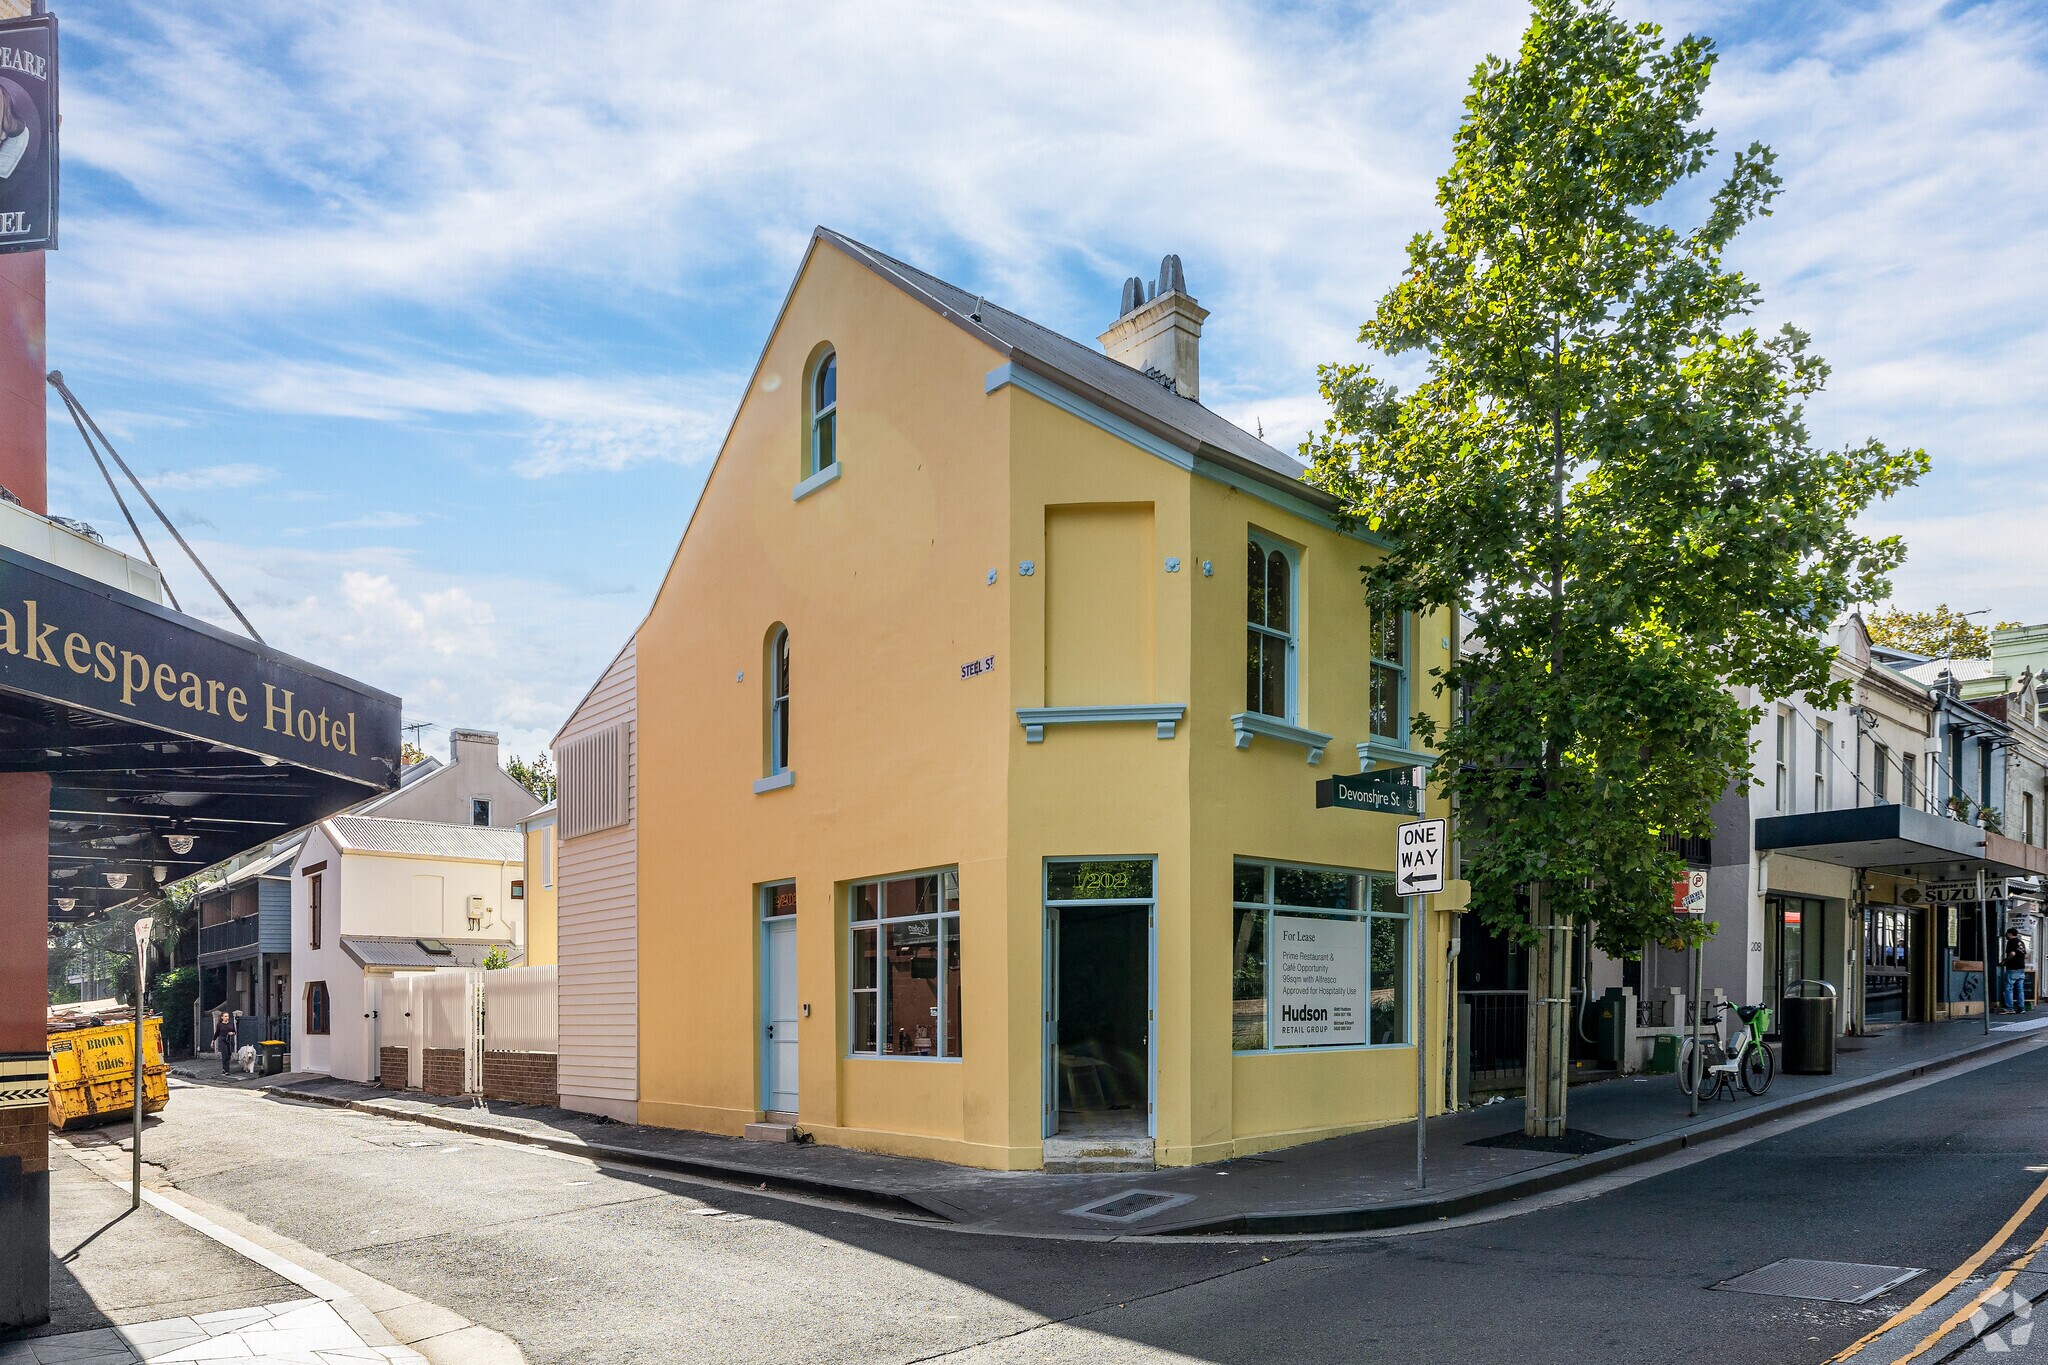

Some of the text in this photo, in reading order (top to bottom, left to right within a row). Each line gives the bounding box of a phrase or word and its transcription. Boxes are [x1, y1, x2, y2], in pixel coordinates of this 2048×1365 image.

[0, 46, 47, 80] EARE
[961, 660, 983, 678] STEEL
[0, 600, 358, 756] akespeare Hotel
[1338, 783, 1400, 806] Devonshire St
[1404, 827, 1437, 846] ONE
[1401, 848, 1438, 868] WAY
[1960, 880, 2002, 888] restrant
[1283, 930, 1316, 942] For Lease
[1750, 942, 1762, 952] 208
[1282, 951, 1299, 960] Prime
[1300, 952, 1329, 961] Restaurant
[1282, 963, 1329, 974] Café Opportunity
[1282, 974, 1337, 984] 99sqm with Alfresco
[1282, 986, 1309, 996] Approved
[1310, 987, 1318, 995] for
[1318, 987, 1346, 996] Hospitality
[1282, 1004, 1328, 1021] Hudson
[1282, 1026, 1304, 1034] RETAIL
[1306, 1025, 1328, 1033] GROUP
[86, 1035, 124, 1050] BROWN
[97, 1057, 125, 1071] BROS
